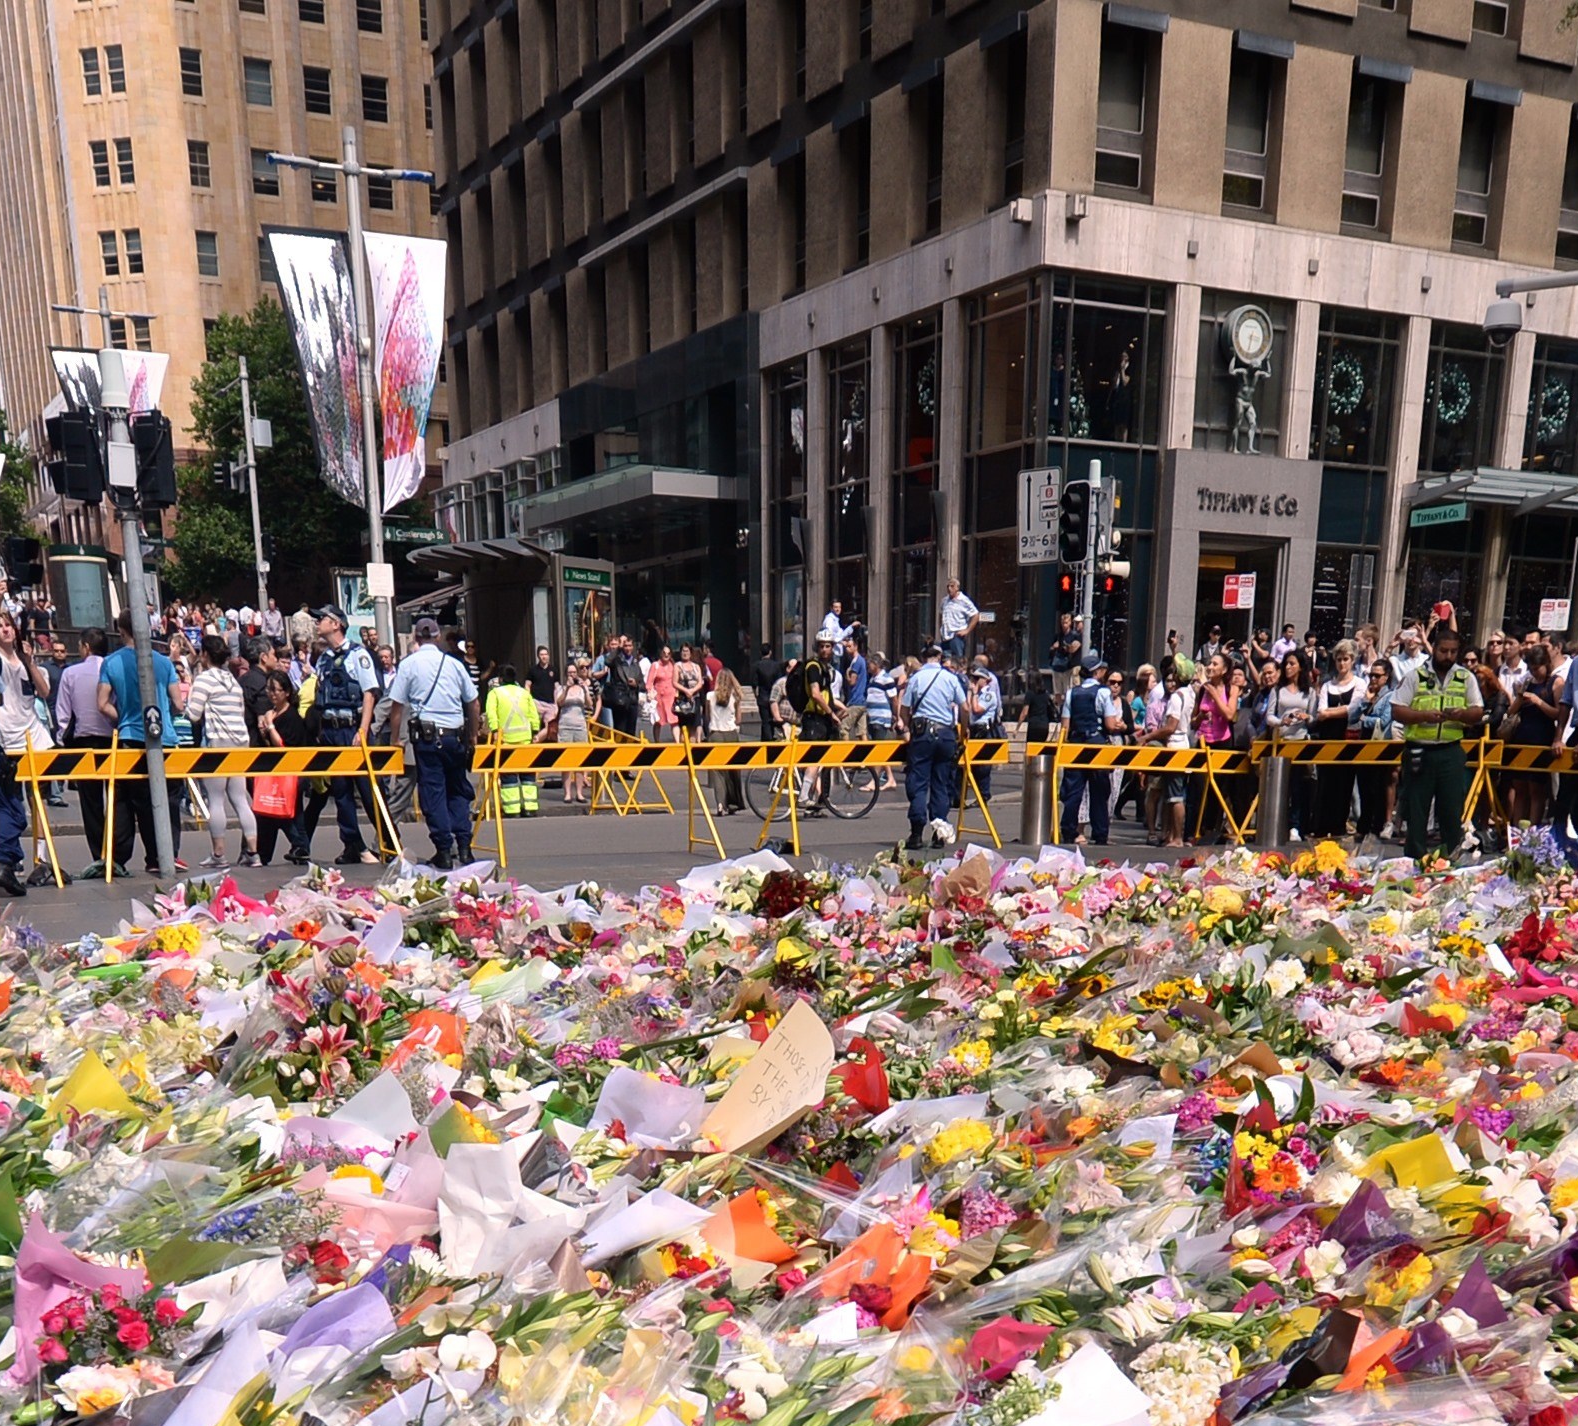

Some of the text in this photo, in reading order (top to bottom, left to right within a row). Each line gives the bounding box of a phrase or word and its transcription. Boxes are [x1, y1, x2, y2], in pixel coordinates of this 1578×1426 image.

[1197, 487, 1259, 515] TIFFANY
[1041, 510, 1057, 519] LANE
[572, 570, 587, 581] News
[760, 1059, 788, 1094] THE
[749, 1084, 772, 1107] BY
